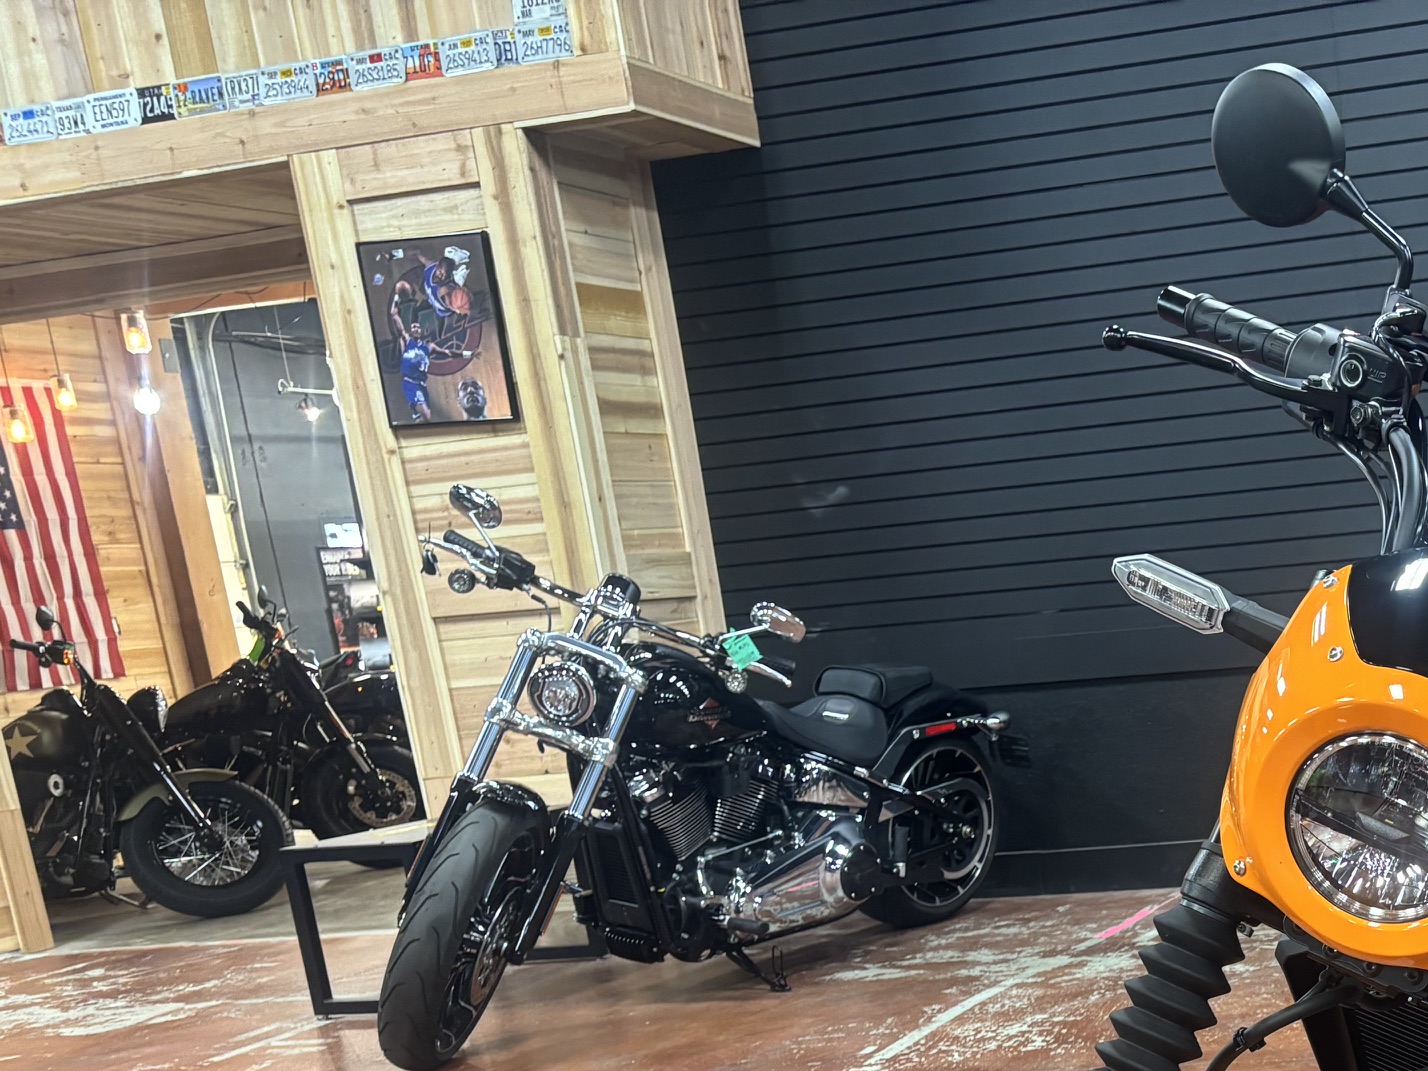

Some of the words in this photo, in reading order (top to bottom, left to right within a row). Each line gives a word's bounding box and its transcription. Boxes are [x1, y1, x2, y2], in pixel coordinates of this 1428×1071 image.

[522, 29, 535, 38] MAY
[521, 37, 571, 57] 26H7796
[446, 47, 490, 69] 26S9413
[355, 62, 400, 84] 26S3185
[264, 78, 309, 98] 25Y3944
[92, 99, 131, 122] EEN597
